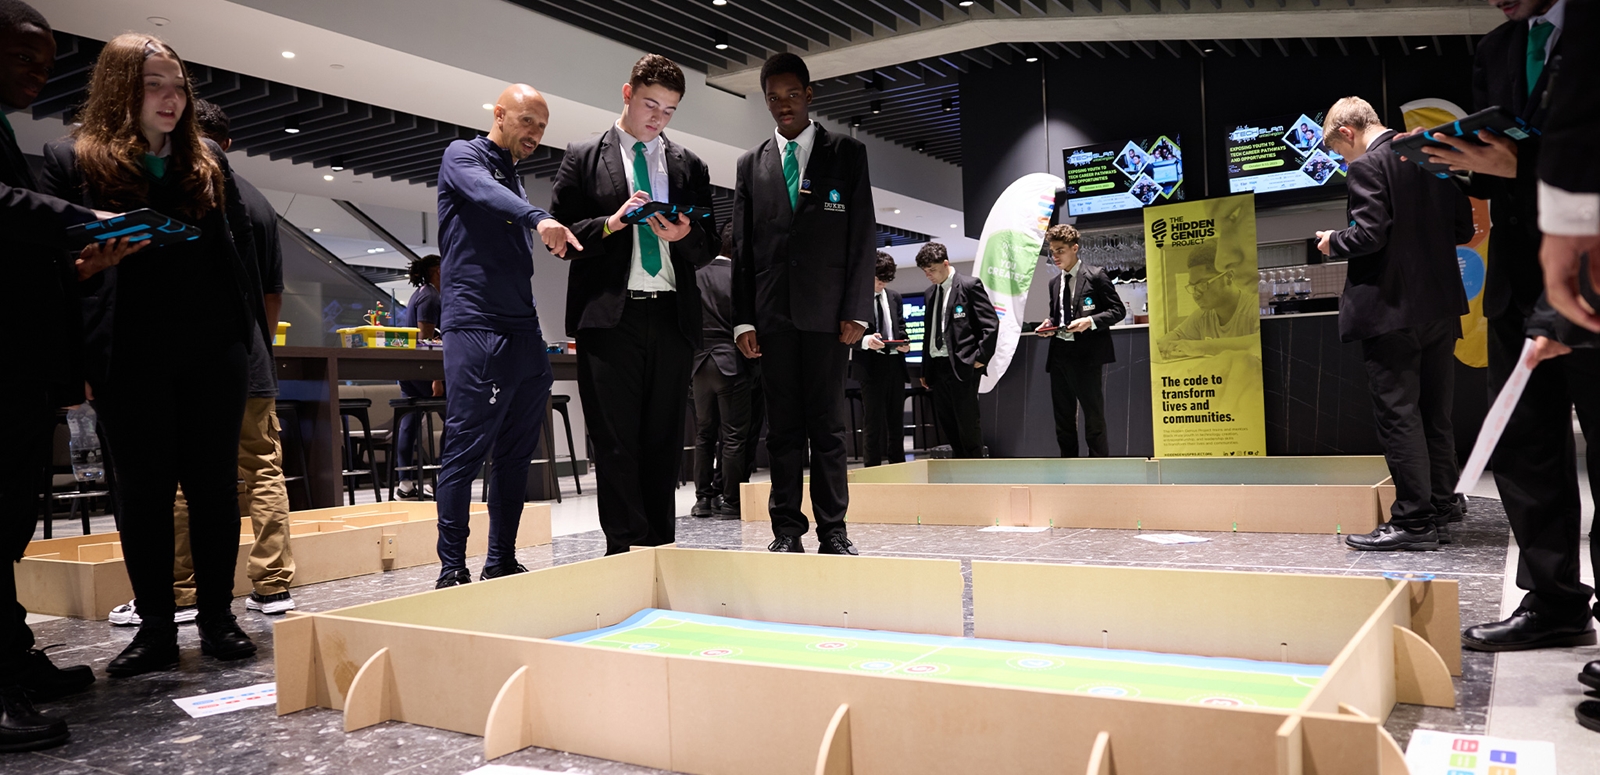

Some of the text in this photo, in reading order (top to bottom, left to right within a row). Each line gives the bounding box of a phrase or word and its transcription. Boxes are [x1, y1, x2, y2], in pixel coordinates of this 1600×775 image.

[1261, 145, 1286, 153] PATHWAYS
[1241, 152, 1276, 161] OPPORTUNITIES
[1171, 219, 1215, 232] HIDDEN
[1171, 228, 1215, 241] GENIUS
[1171, 238, 1205, 247] PROJECT
[1000, 258, 1017, 270] YOU
[1161, 374, 1223, 387] The code to
[1161, 387, 1216, 399] transform
[1162, 399, 1210, 411] lives and
[1163, 411, 1235, 424] communities.
